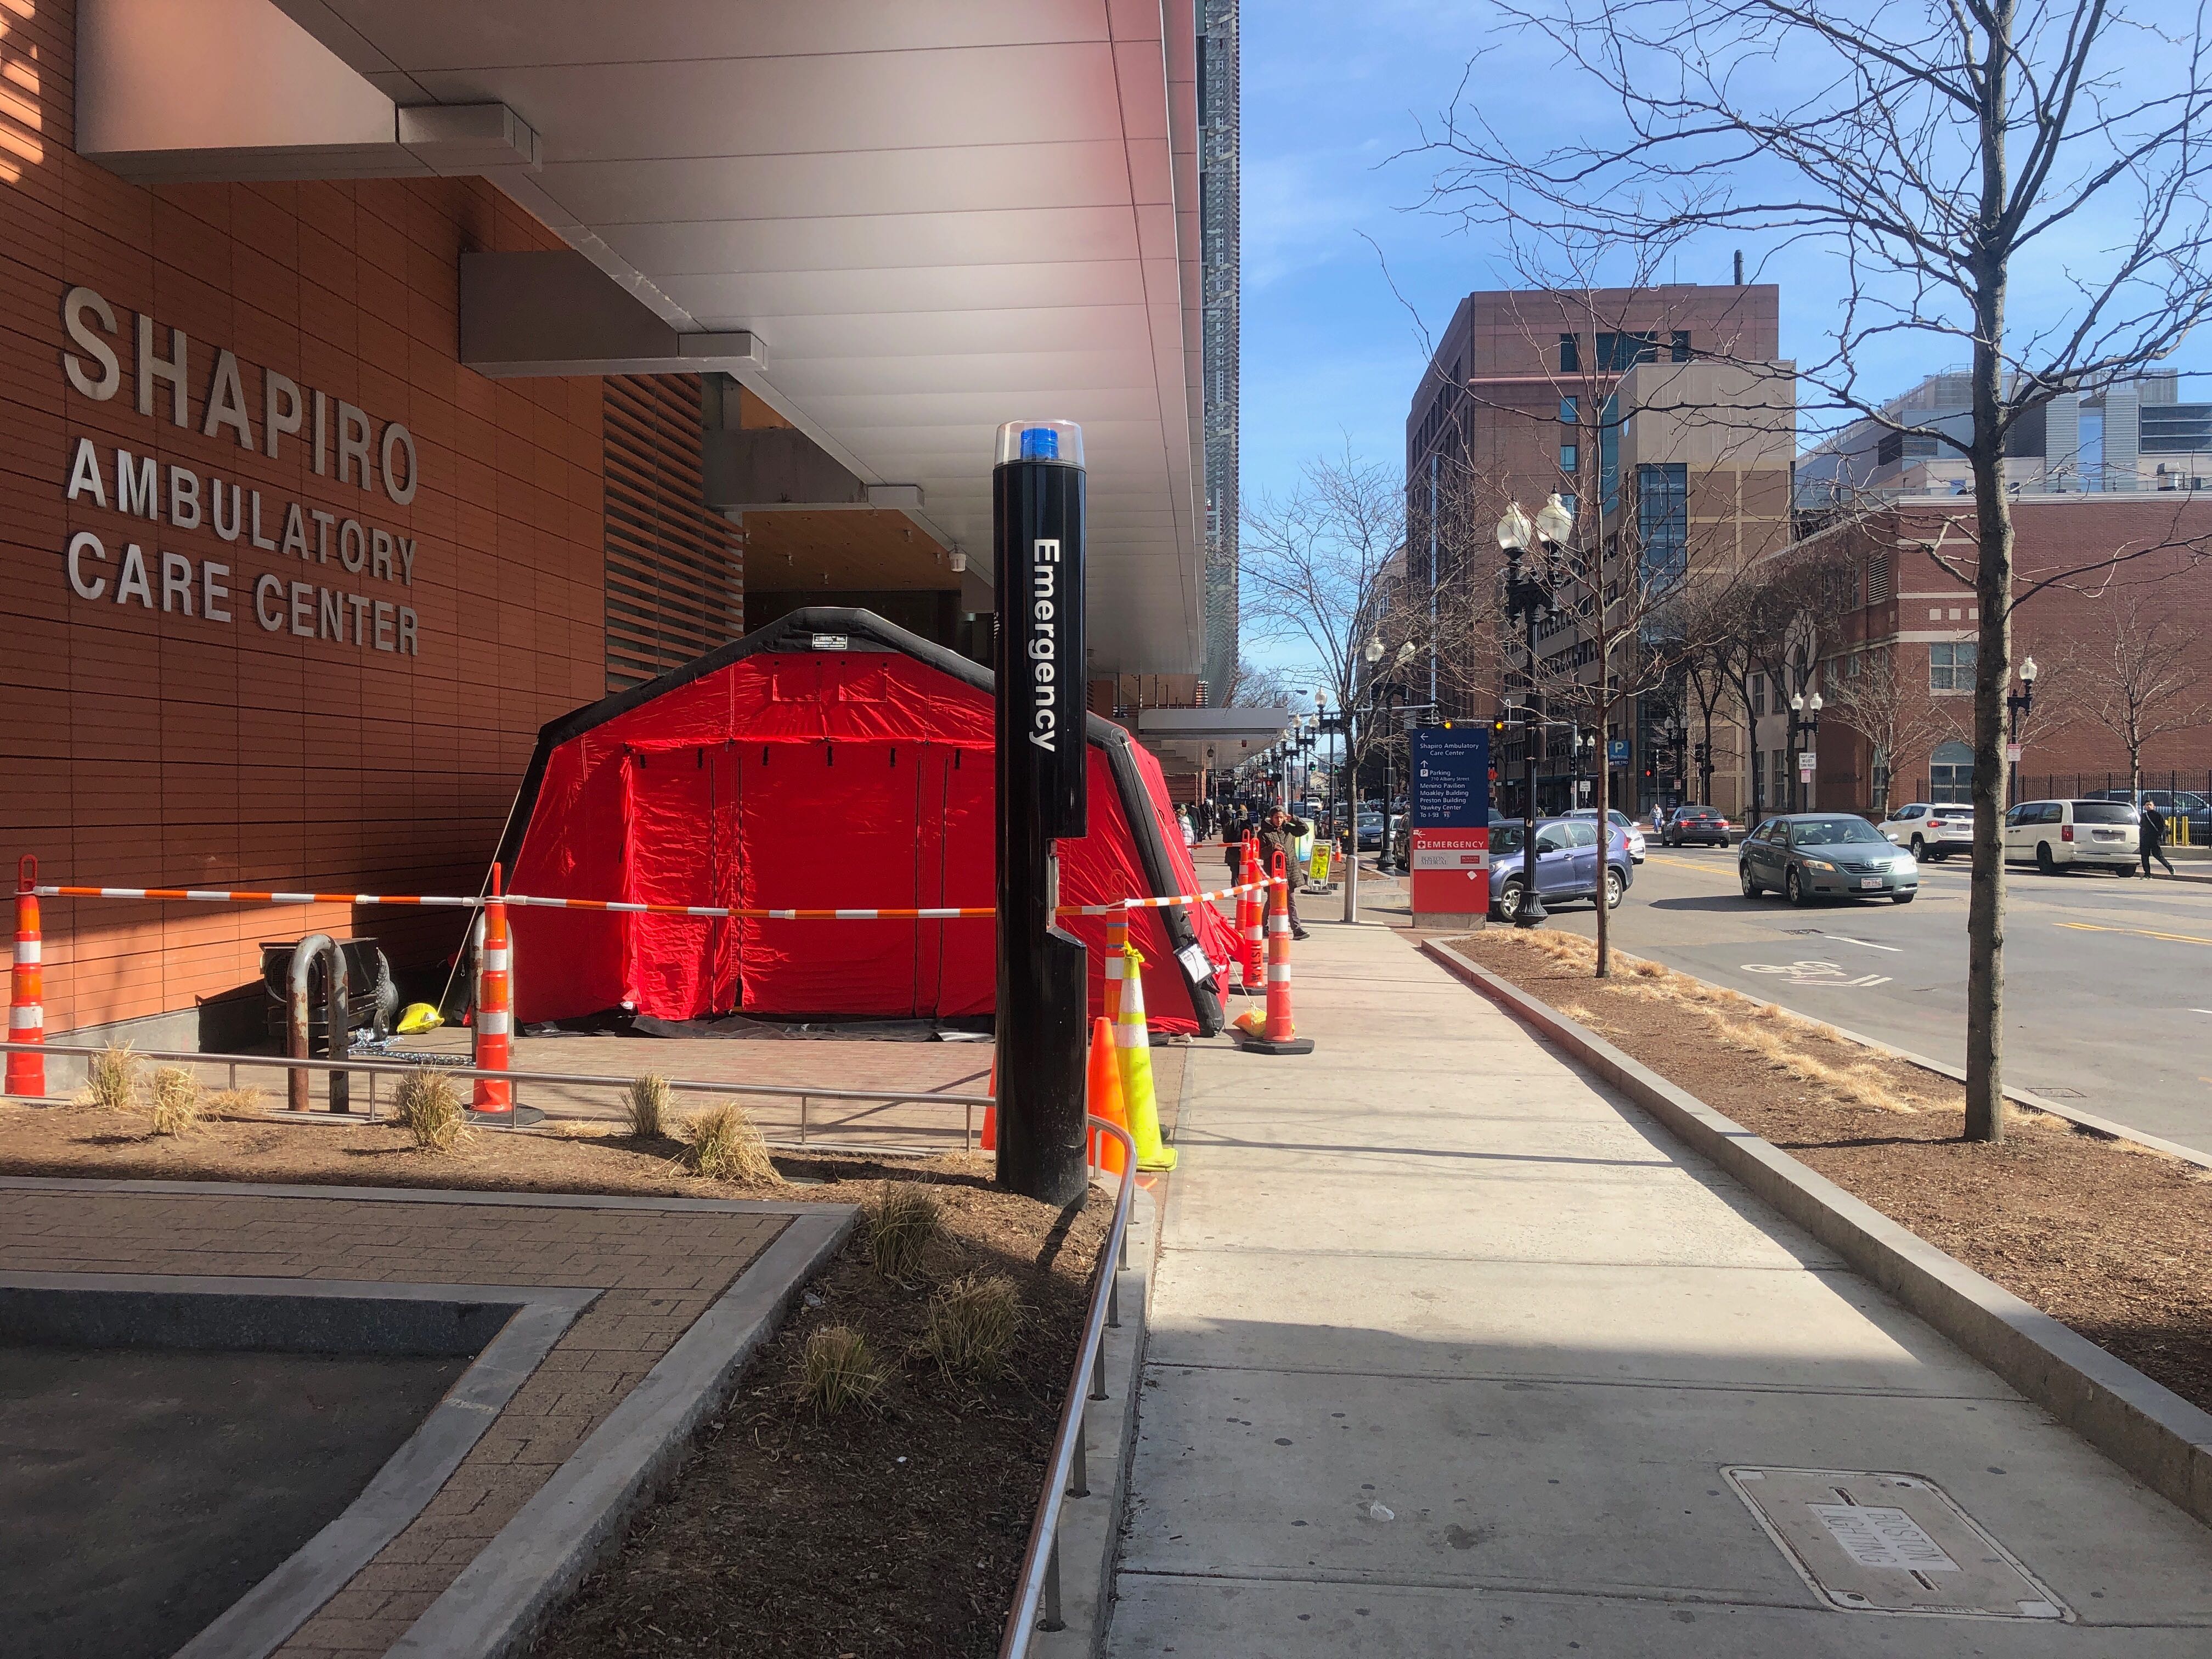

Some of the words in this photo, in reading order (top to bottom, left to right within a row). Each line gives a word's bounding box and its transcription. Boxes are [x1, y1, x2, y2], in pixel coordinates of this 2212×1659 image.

[62, 286, 419, 506] SHAPIRO
[67, 437, 417, 586] AMBULATORY
[67, 531, 232, 623] CARE
[256, 573, 419, 656] CENTER
[1028, 539, 1060, 753] Emergency
[1615, 742, 1624, 753] P
[1818, 1508, 1898, 1563] LIGHTING
[1866, 1513, 1945, 1561] BOSTON
